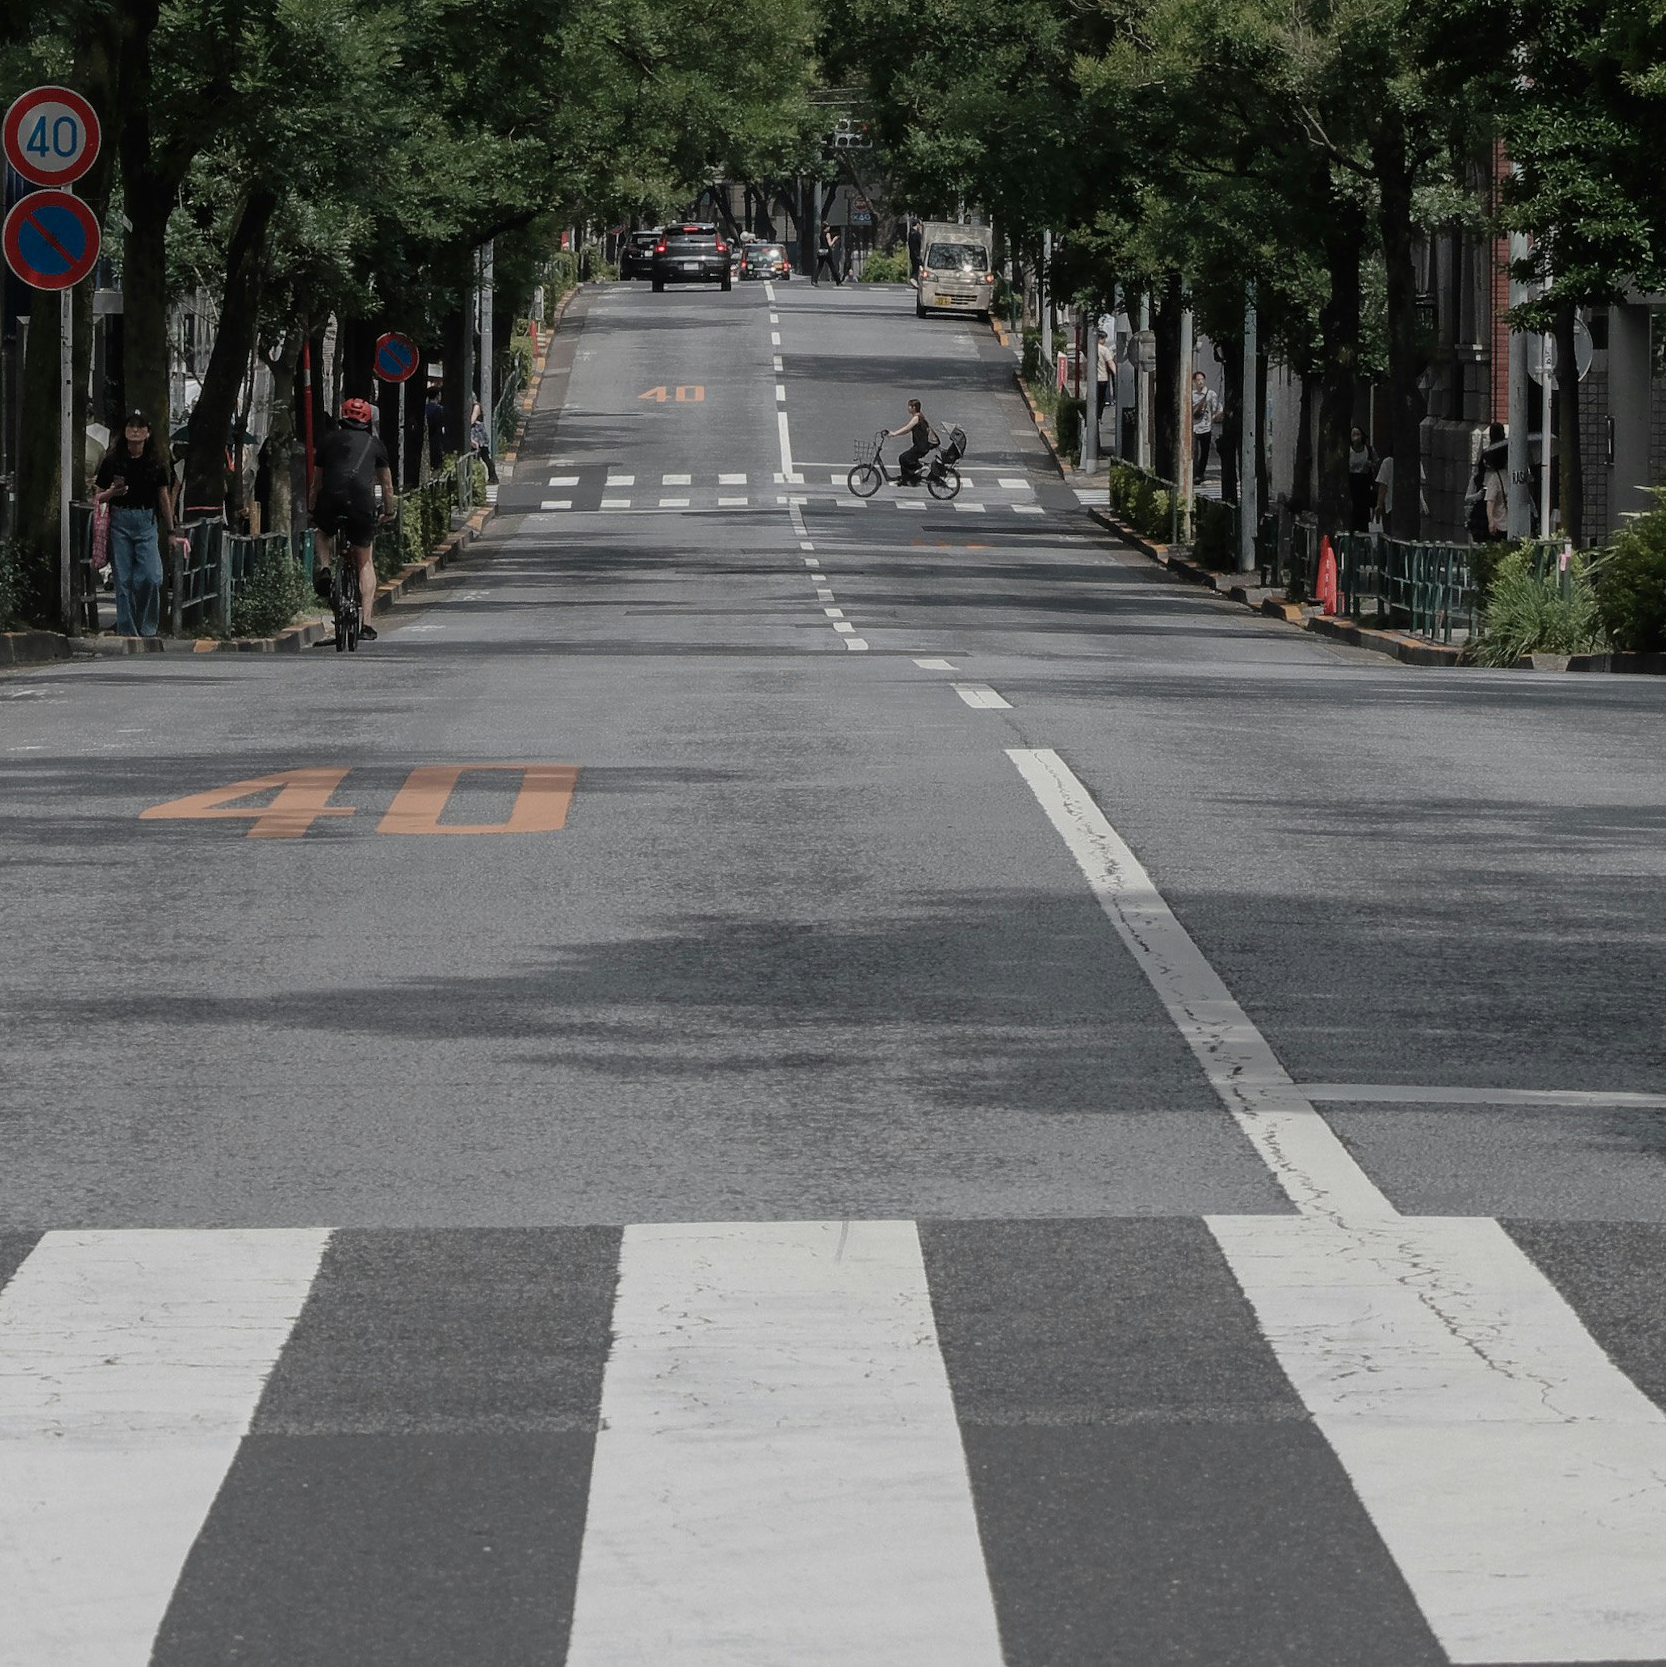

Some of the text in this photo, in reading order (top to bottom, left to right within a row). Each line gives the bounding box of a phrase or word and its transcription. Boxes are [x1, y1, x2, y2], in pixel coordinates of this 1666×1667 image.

[26, 115, 77, 158] 40
[637, 385, 715, 403] 40
[138, 763, 581, 839] 40
